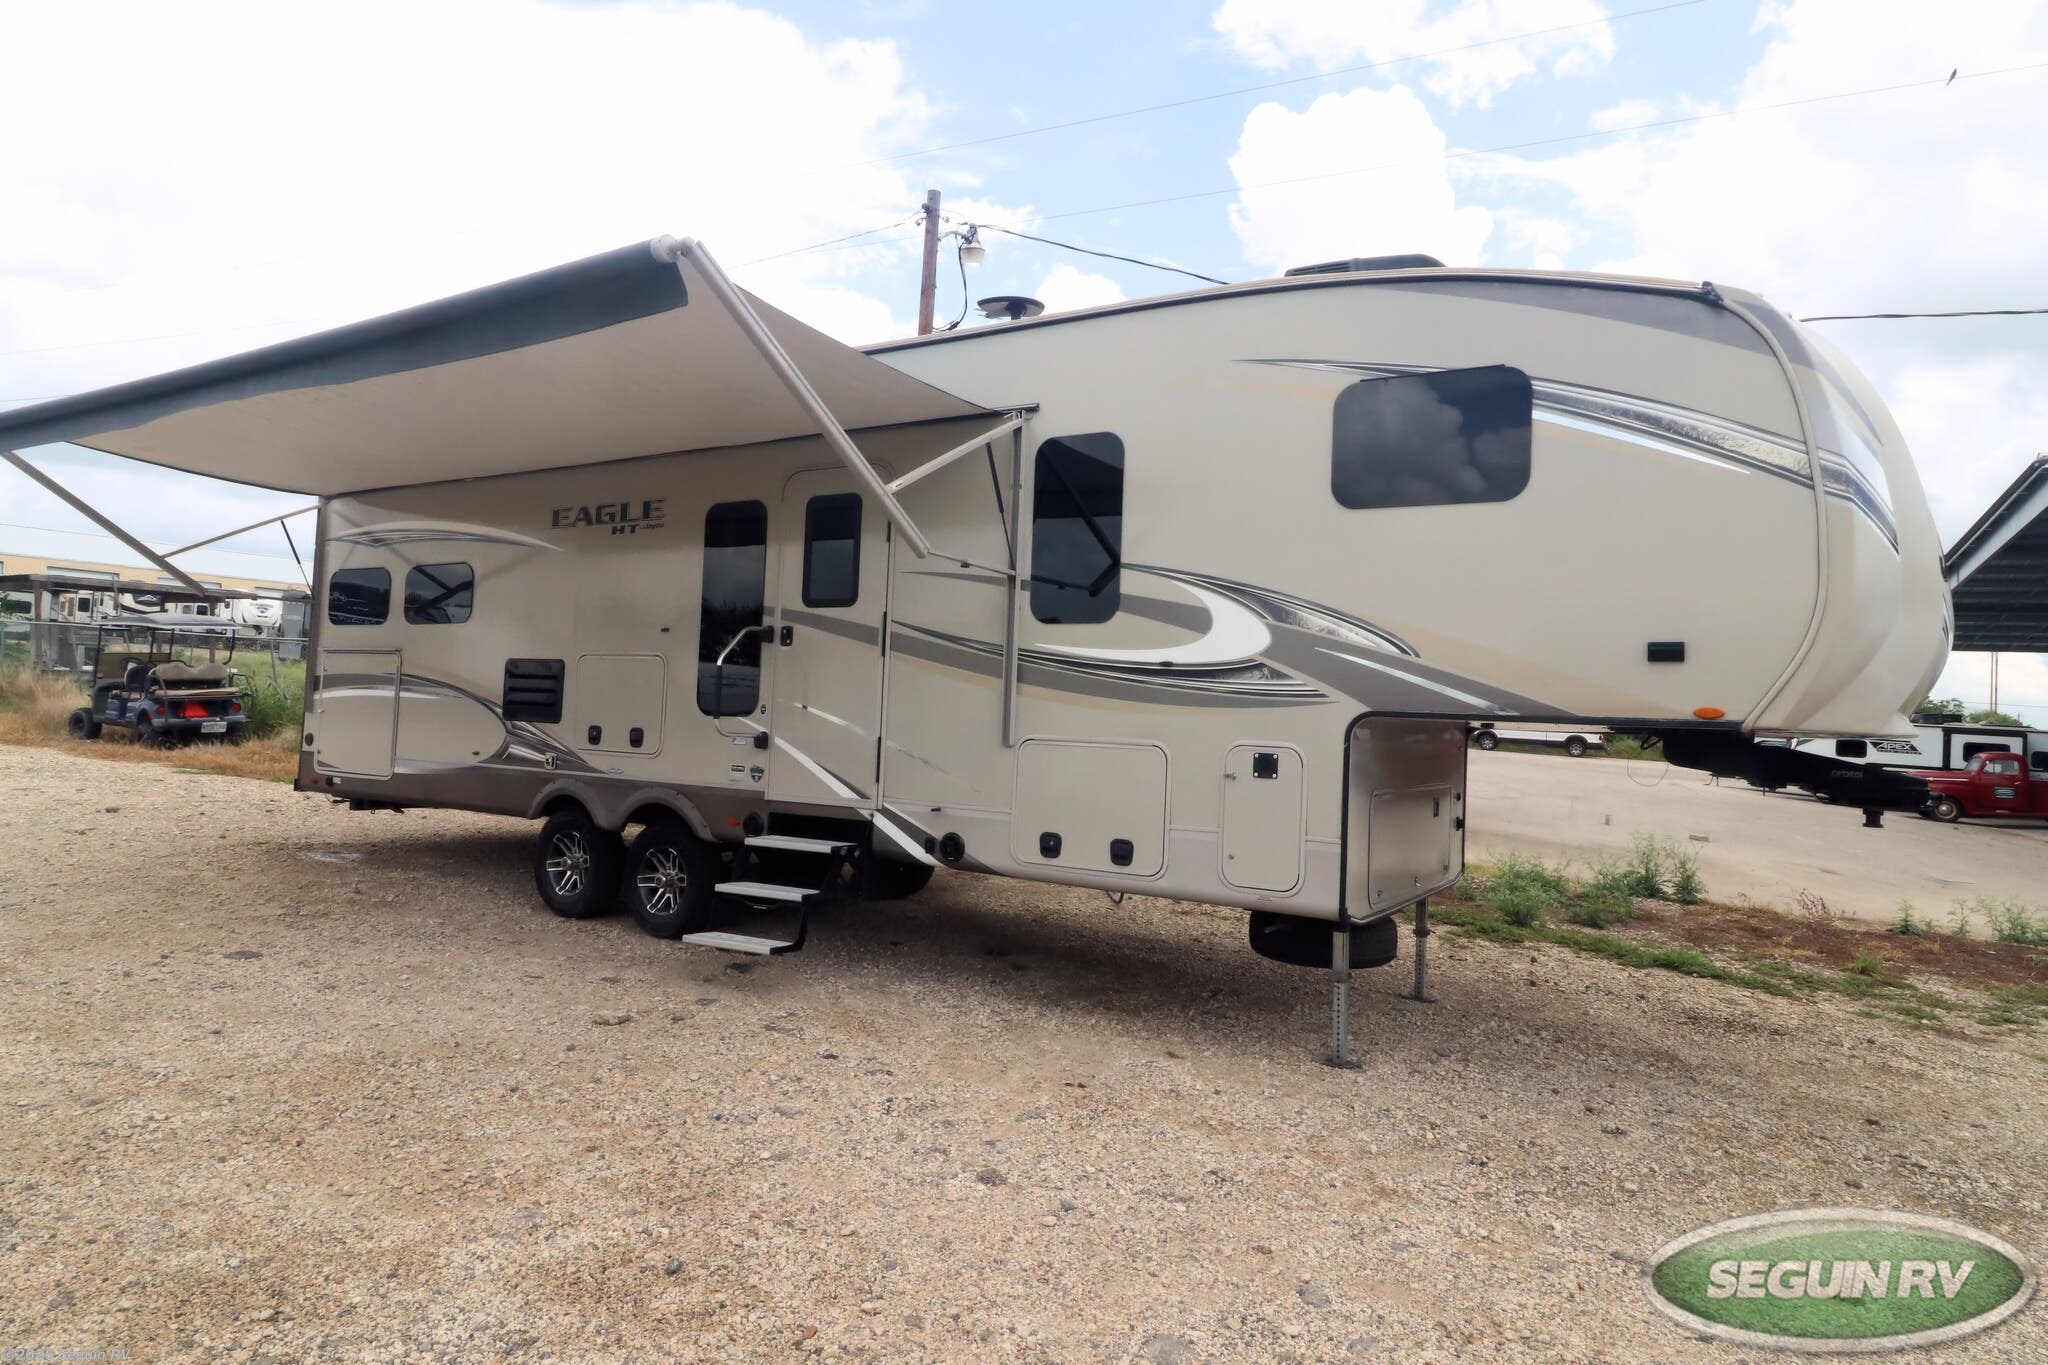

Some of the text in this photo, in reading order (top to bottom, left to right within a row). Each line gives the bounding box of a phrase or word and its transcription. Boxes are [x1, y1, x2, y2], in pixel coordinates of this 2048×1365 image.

[552, 498, 666, 529] EAGLE
[611, 524, 640, 535] HT
[1877, 742, 1911, 751] APEX
